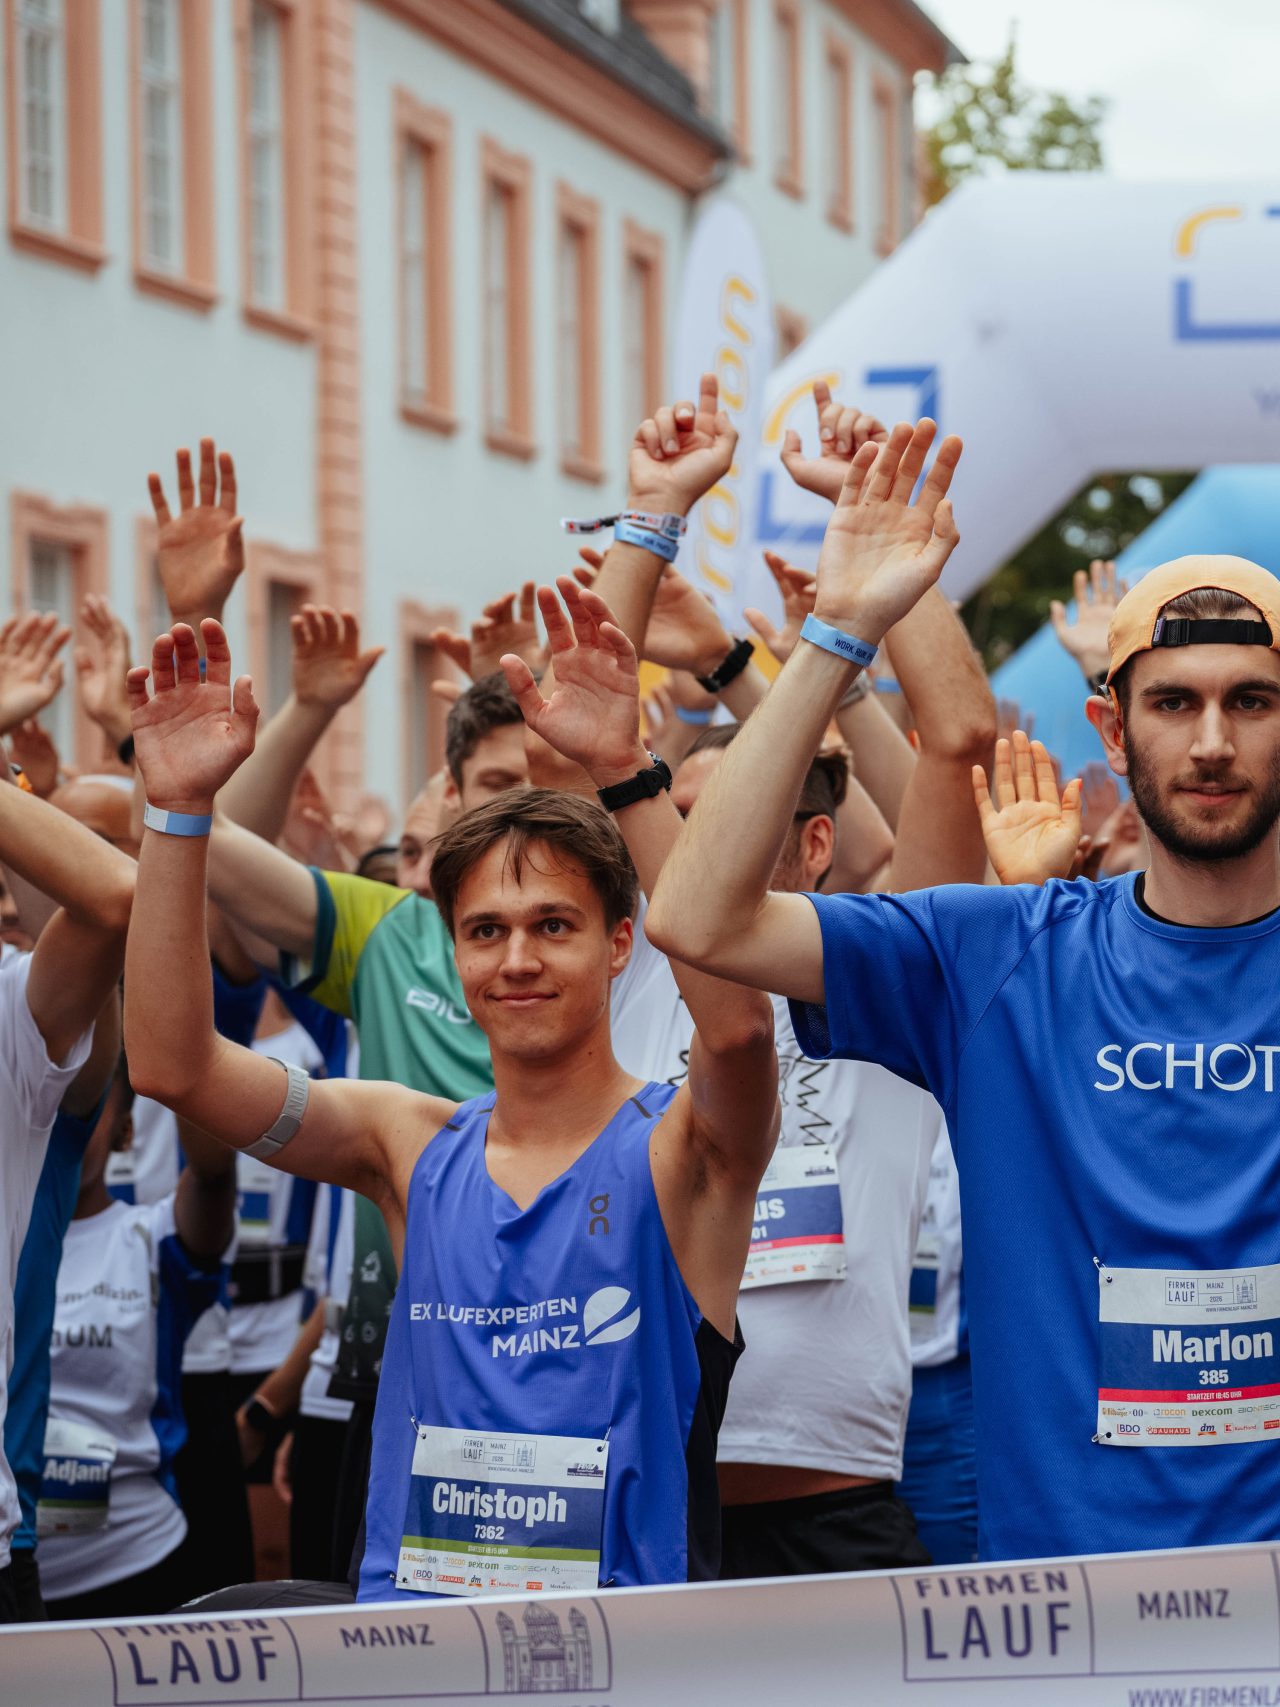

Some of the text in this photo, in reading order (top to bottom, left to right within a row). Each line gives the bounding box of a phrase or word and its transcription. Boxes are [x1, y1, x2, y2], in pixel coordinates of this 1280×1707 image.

[697, 277, 755, 593] roon
[754, 1198, 786, 1221] us
[1168, 1281, 1195, 1289] FIRMEN
[1168, 1290, 1195, 1302] LAUF
[436, 1297, 577, 1325] LUFEXPERTEN
[492, 1325, 581, 1358] MAINZ
[1152, 1328, 1274, 1364] Marlon
[1198, 1369, 1230, 1385] 385
[1119, 1424, 1140, 1433] BDO
[1200, 1423, 1215, 1432] dm
[432, 1482, 567, 1528] Christoph
[474, 1524, 505, 1540] 7362
[916, 1570, 1070, 1600] FIRMEN
[1138, 1588, 1231, 1621] MAINZ
[339, 1623, 434, 1649] MAINZ
[922, 1602, 1072, 1661] LAUF
[126, 1635, 278, 1686] LAUF
